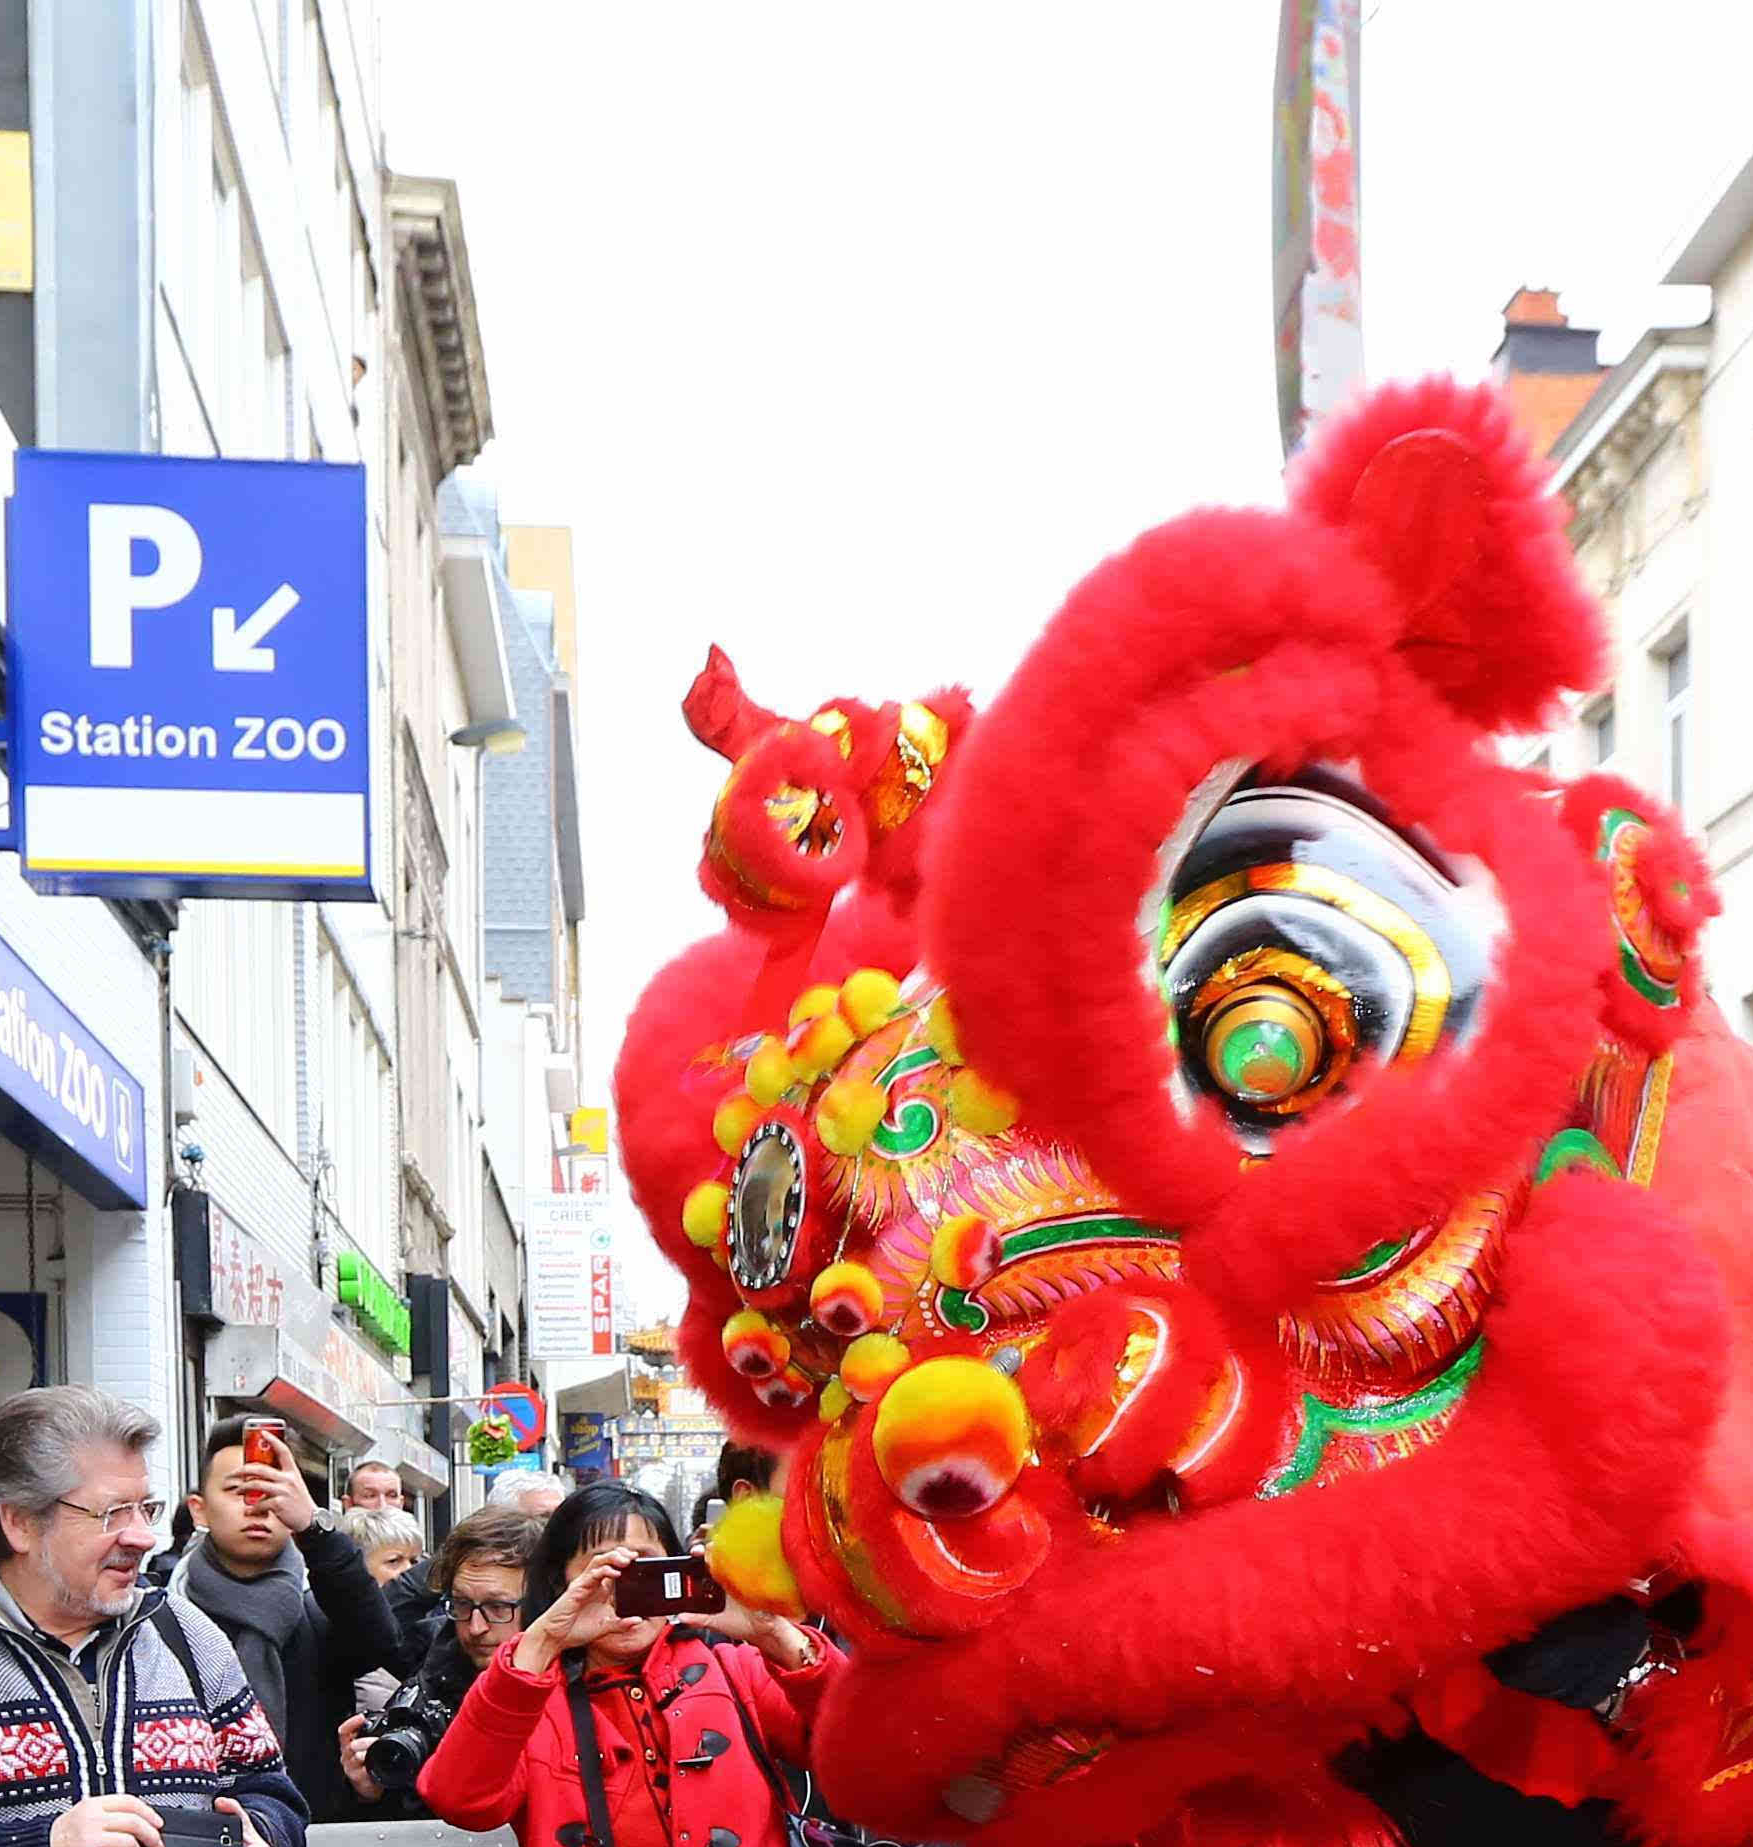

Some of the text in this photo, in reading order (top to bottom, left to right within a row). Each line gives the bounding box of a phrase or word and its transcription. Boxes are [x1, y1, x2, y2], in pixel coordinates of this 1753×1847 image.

[85, 502, 205, 670] P
[39, 711, 348, 763] Station ZOO
[57, 1030, 110, 1142] ZOO
[592, 1255, 610, 1333] SPAR
